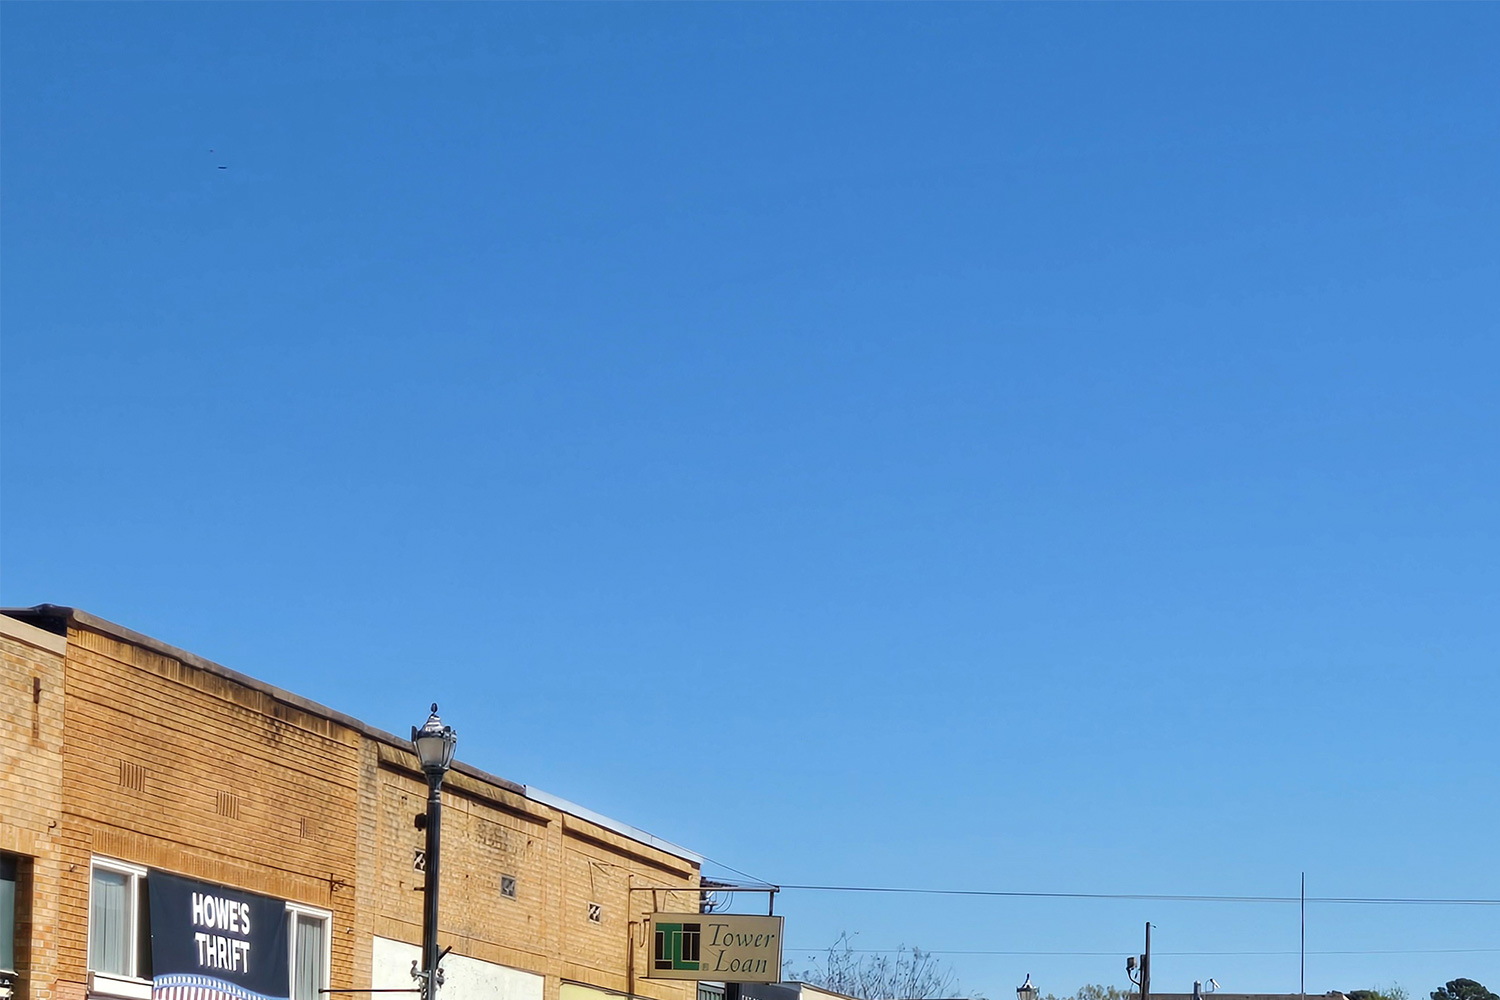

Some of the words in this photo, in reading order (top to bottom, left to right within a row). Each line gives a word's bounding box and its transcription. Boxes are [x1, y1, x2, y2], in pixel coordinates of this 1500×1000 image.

[192, 892, 251, 935] HOWE'S
[708, 923, 775, 948] Tower
[195, 932, 250, 974] THRIFT
[713, 949, 767, 973] Loan
